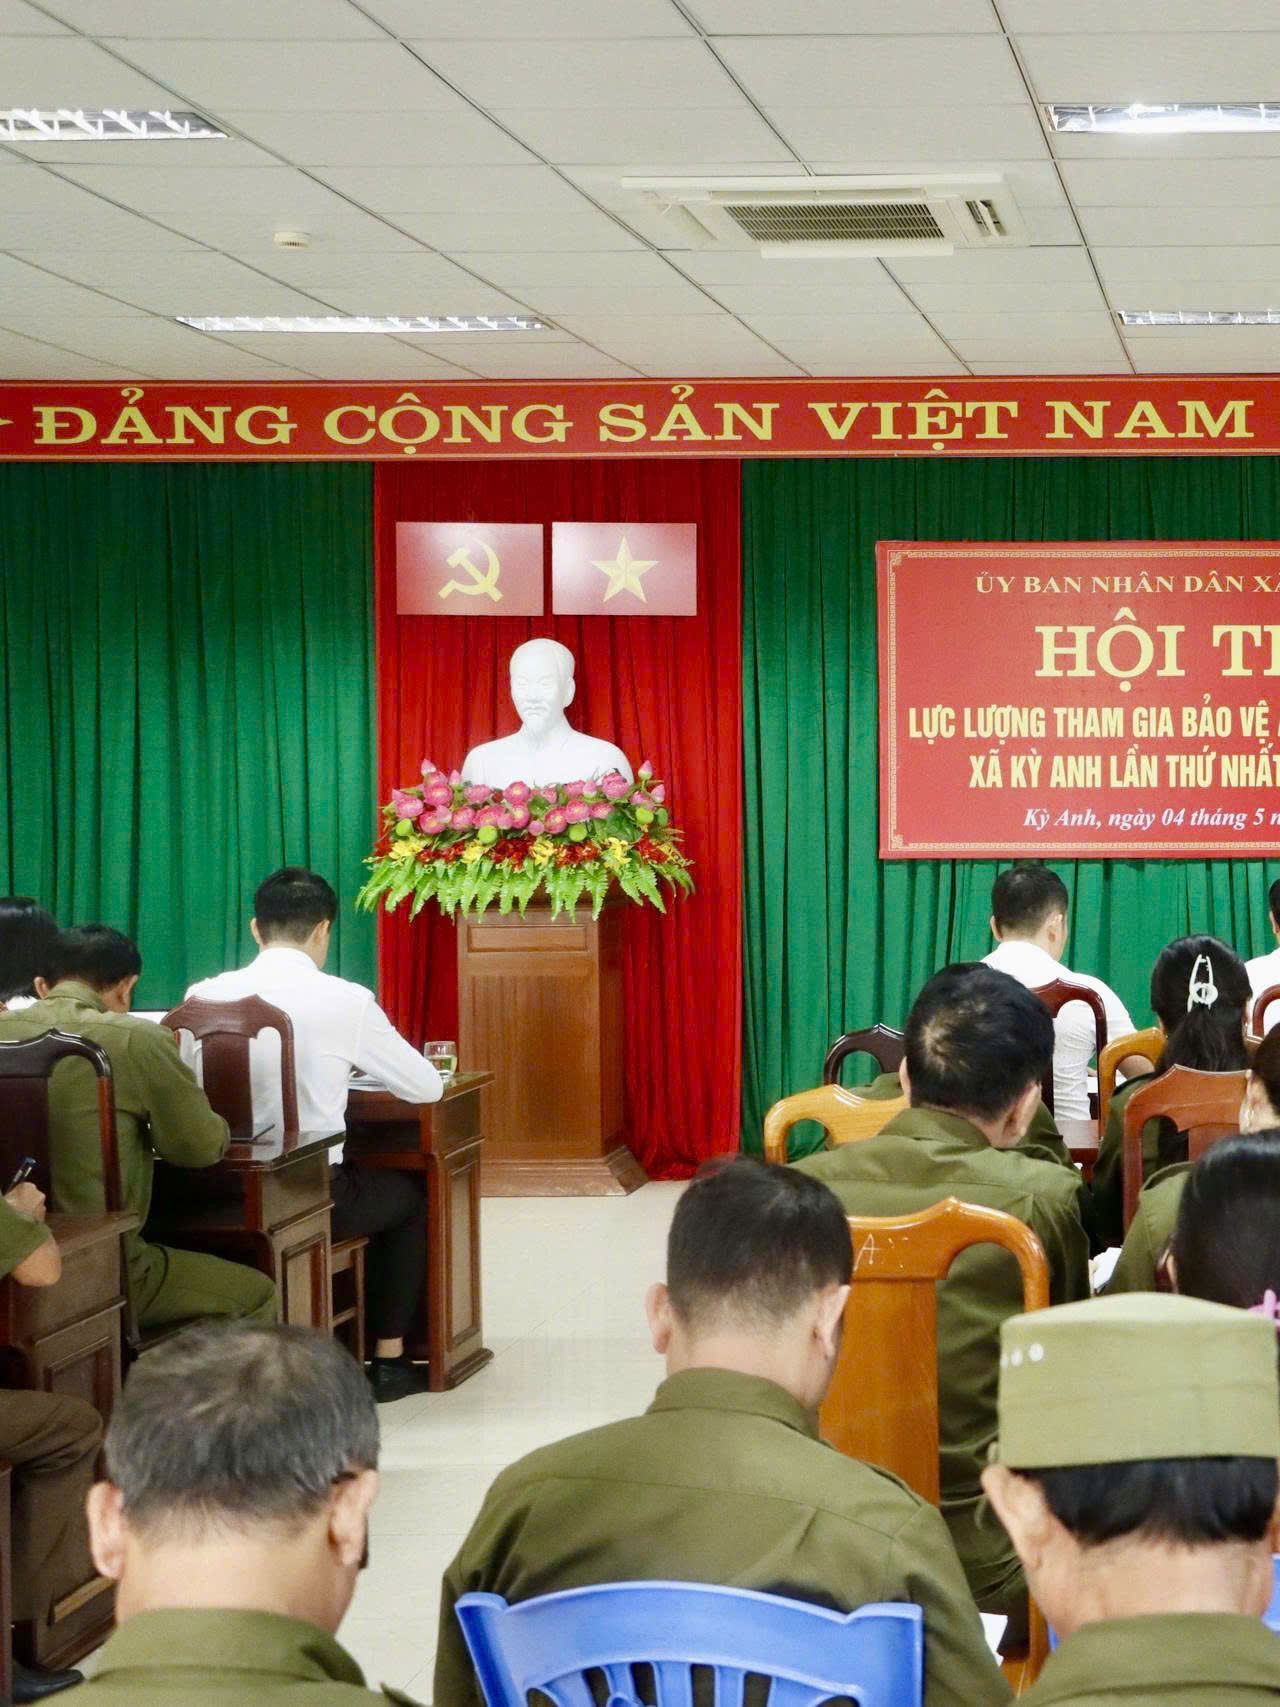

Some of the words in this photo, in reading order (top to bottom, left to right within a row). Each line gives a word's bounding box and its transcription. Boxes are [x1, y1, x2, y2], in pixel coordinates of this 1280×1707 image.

[33, 387, 298, 445] ĐẢNG
[323, 392, 574, 455] CỘNG
[598, 383, 780, 443] SẢN
[807, 388, 1018, 451] VIỆT
[1045, 400, 1255, 439] NAM
[976, 571, 1016, 594] ỦY
[1023, 576, 1082, 594] BAN
[1091, 570, 1174, 594] NHÂN
[1184, 570, 1243, 593] DÂN
[1034, 606, 1186, 693] HỘI
[908, 703, 956, 745] LỰC
[963, 703, 1047, 746] LƯỢNG
[1052, 706, 1125, 739] THAM
[1132, 706, 1175, 739] GIA
[1181, 692, 1233, 738] BẢO
[1239, 699, 1270, 745] VỆ
[968, 748, 1004, 789] XÃ
[1009, 747, 1043, 789] KỲ
[1049, 754, 1102, 789] ANH
[1109, 743, 1159, 788] LẦN
[1164, 744, 1217, 788] THỨ
[1022, 807, 1051, 832] Kỳ
[1052, 807, 1102, 830] Anh,
[1107, 807, 1156, 831] ngày
[1161, 807, 1186, 826] 04
[1190, 807, 1248, 831] tháng
[1252, 807, 1265, 826] 5
